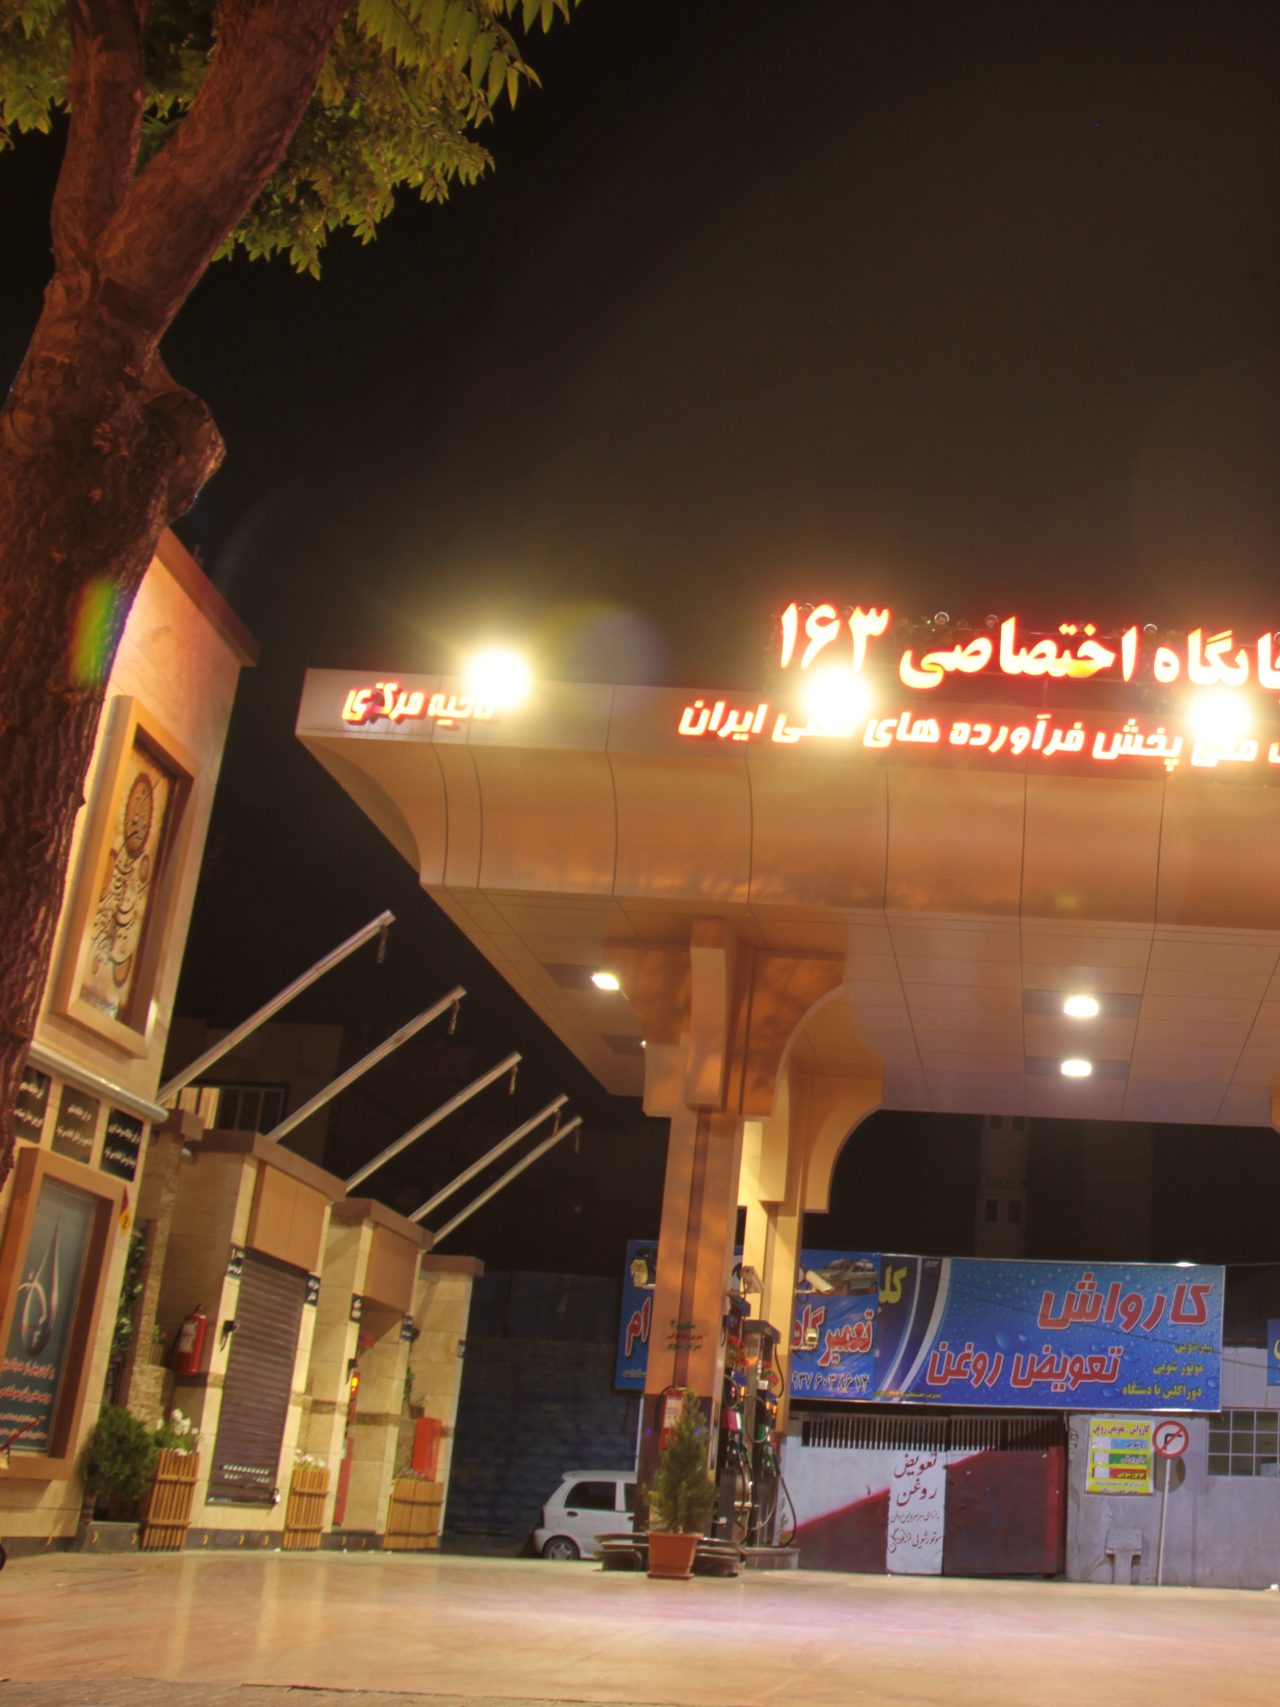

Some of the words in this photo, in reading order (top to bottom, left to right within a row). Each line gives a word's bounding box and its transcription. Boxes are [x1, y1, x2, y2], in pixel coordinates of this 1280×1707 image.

[779, 602, 890, 674] ۱۶۳
[899, 616, 1138, 690] اختصاصی
[678, 699, 769, 742] ایران
[862, 711, 941, 749] های
[949, 714, 1085, 757] فرآورده
[1092, 717, 1183, 772] پخش
[1037, 1271, 1213, 1333] کارواش
[926, 1340, 1003, 1387] روغن
[1010, 1345, 1124, 1392] تعویض
[893, 1452, 938, 1479] تعویض
[896, 1478, 937, 1507] روغن
